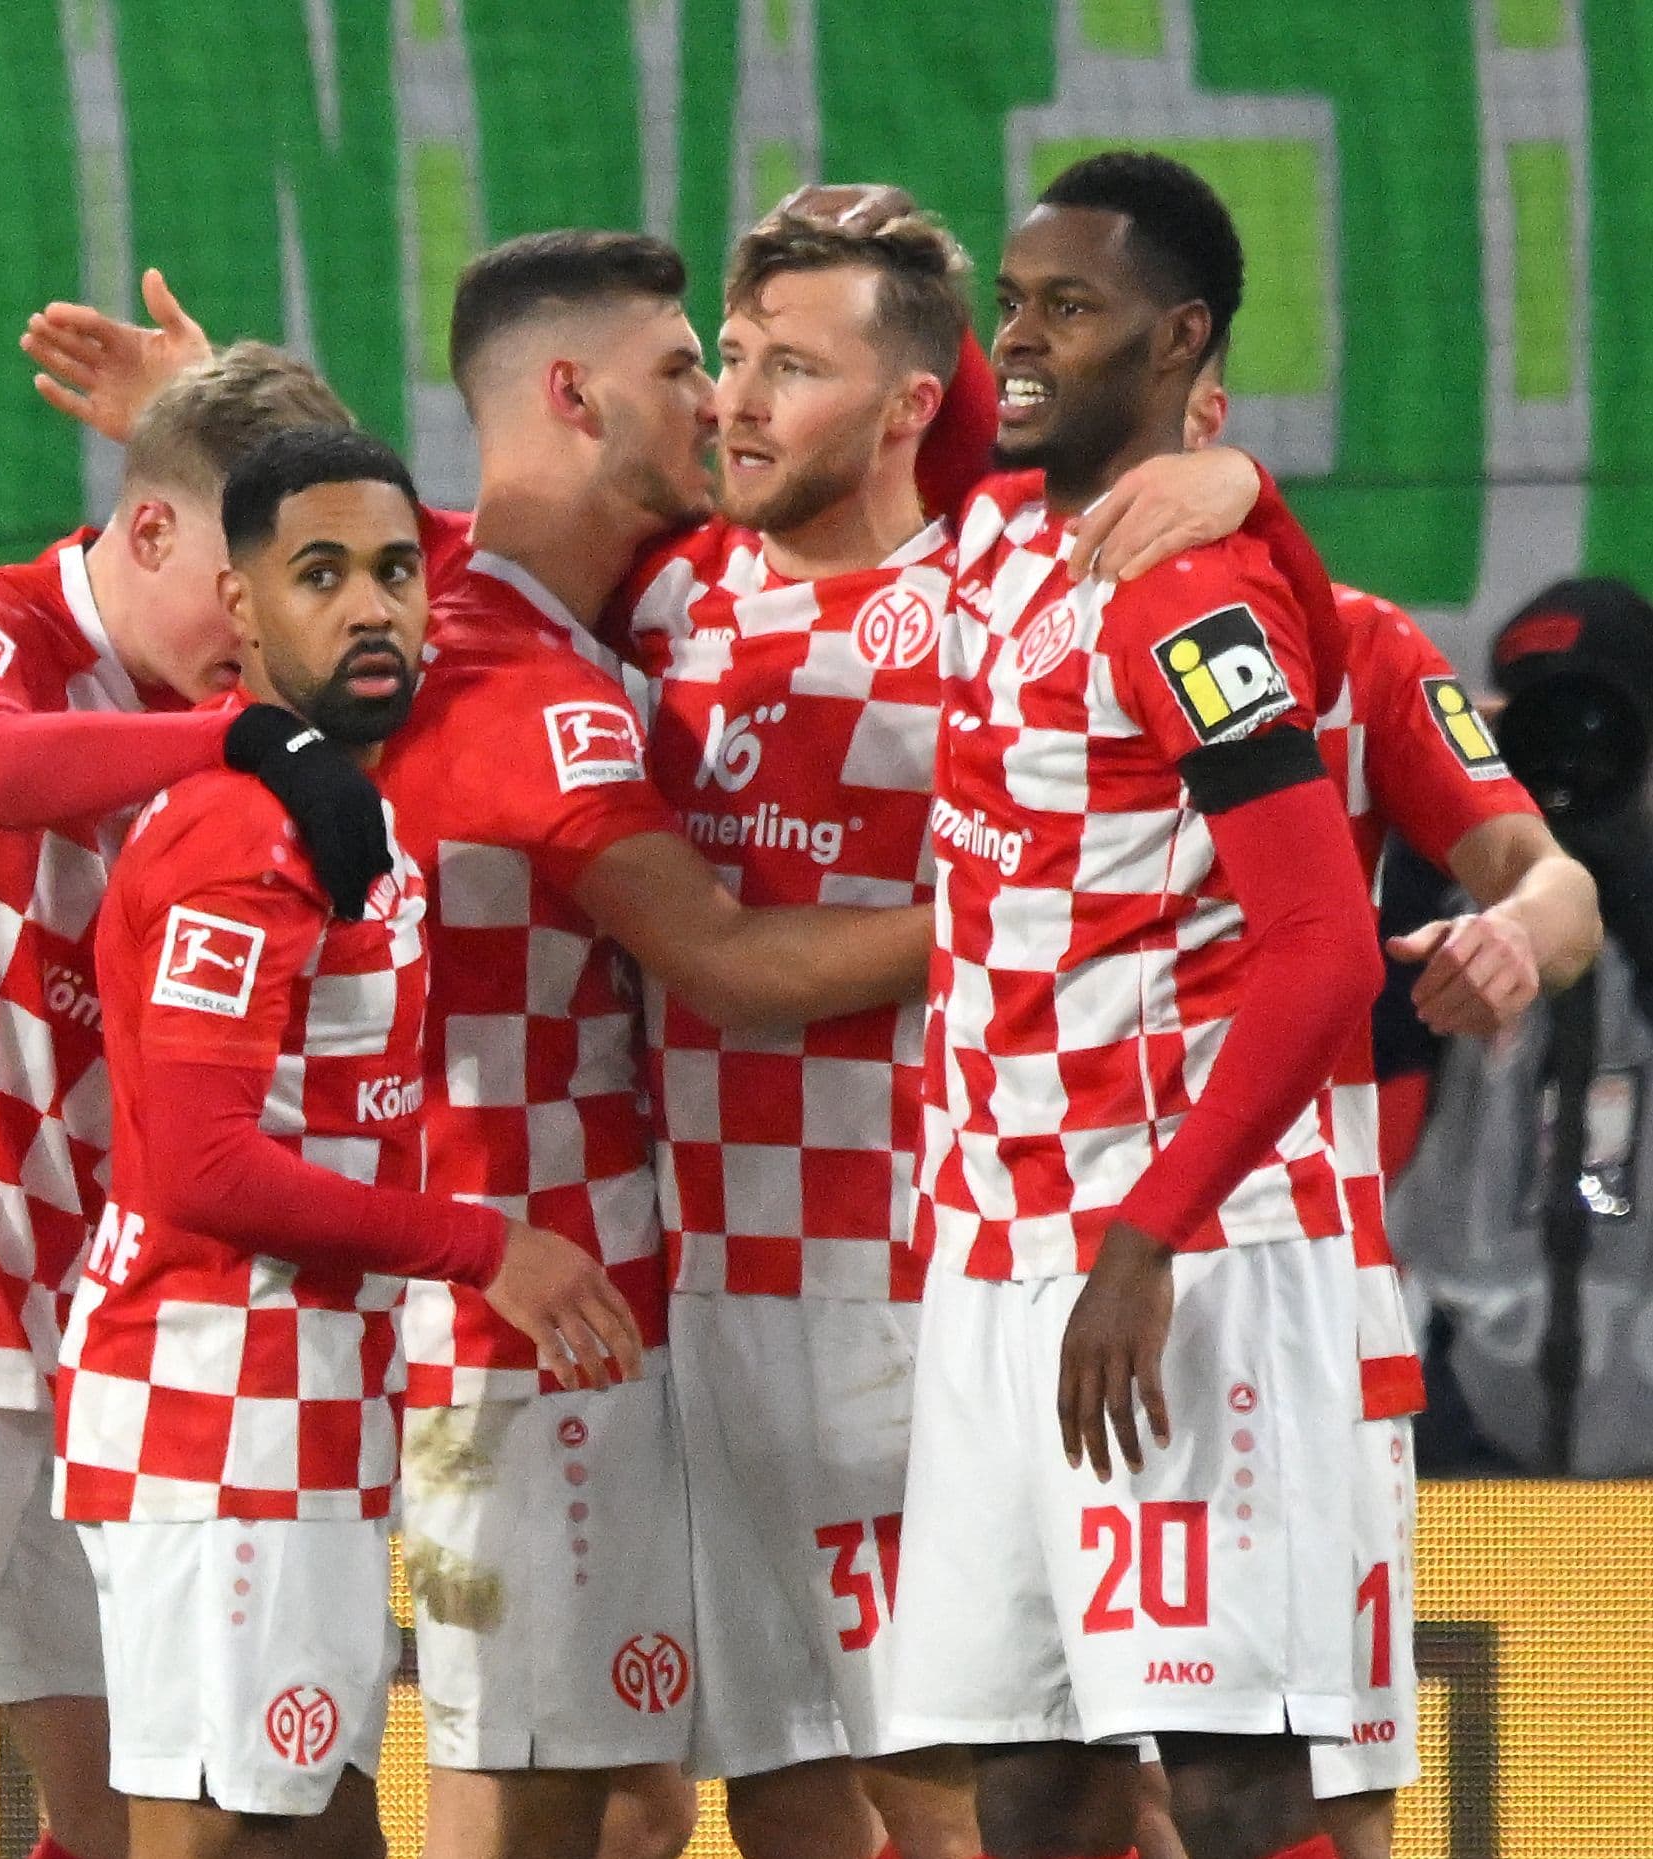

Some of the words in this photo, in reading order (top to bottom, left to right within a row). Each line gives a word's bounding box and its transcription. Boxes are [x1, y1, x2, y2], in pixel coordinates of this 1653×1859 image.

[1080, 1501, 1209, 1635] 20
[1144, 1660, 1215, 1685] JAKO
[1352, 1719, 1397, 1744] AKO
